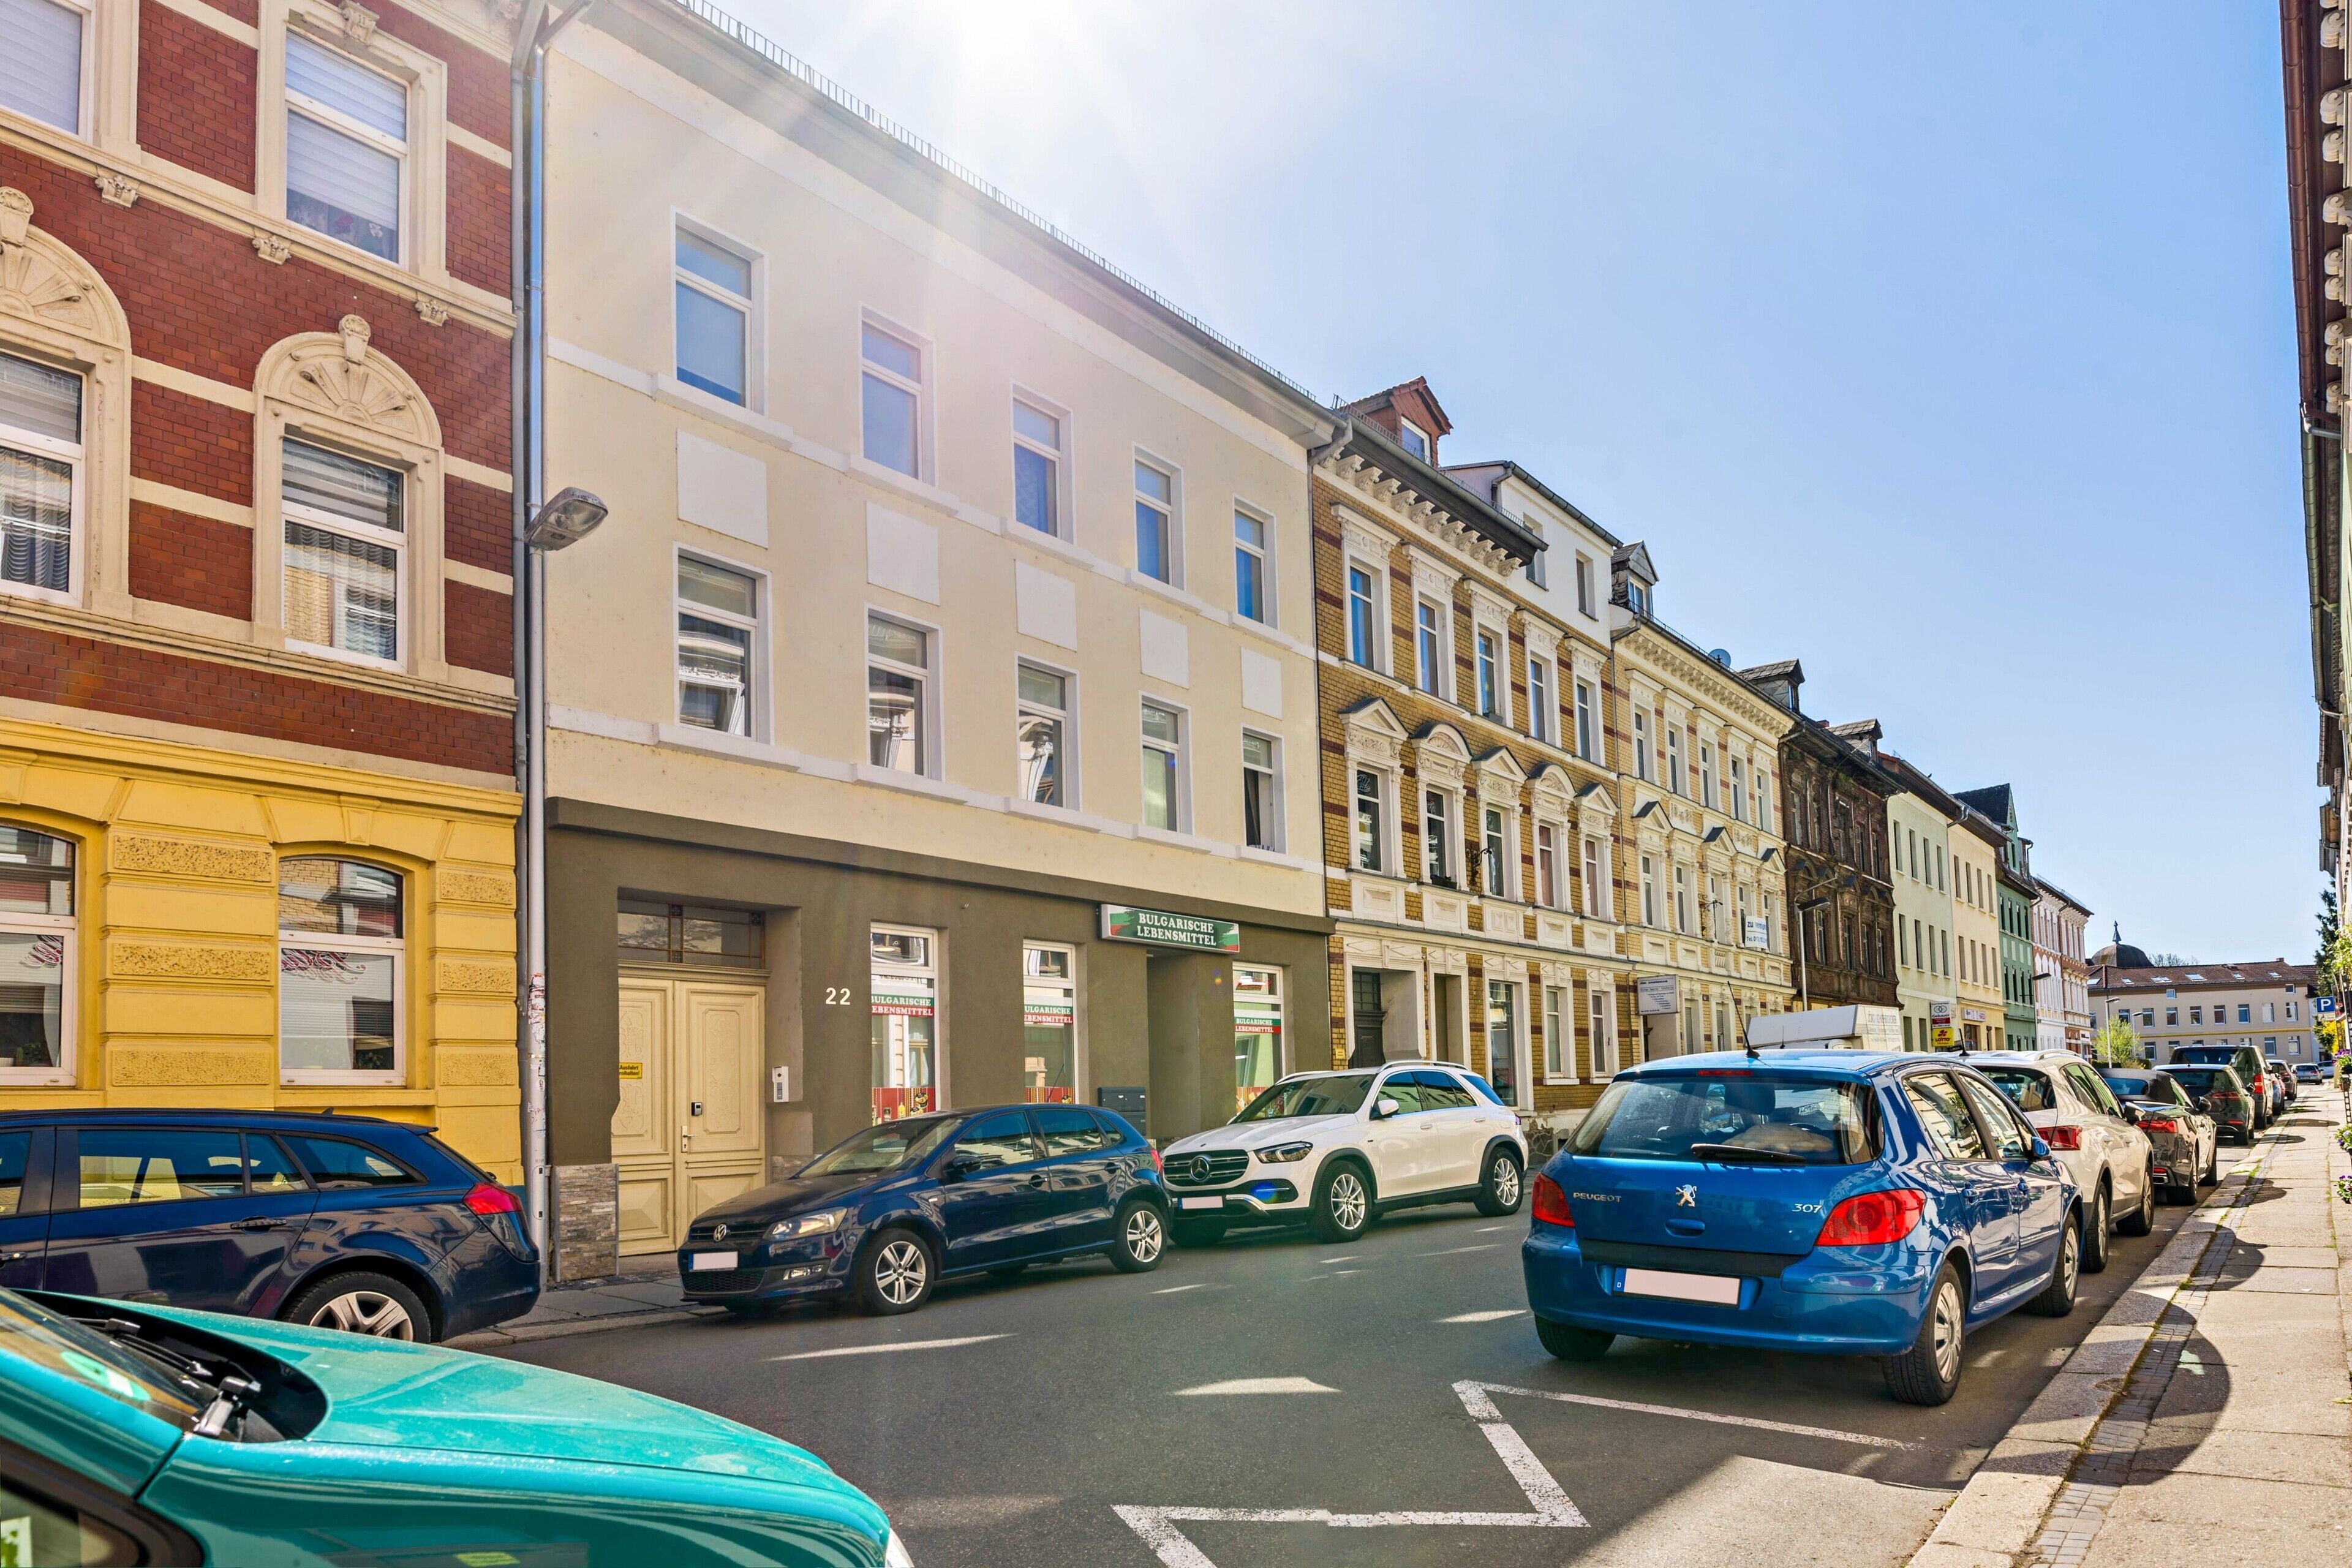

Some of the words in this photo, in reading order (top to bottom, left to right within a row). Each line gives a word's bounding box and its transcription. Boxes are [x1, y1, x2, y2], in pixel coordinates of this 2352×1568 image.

[1138, 913, 1214, 933] BULGARISCHE
[1137, 925, 1216, 946] LEBENSMITTEL
[825, 987, 851, 1005] 22
[2321, 998, 2332, 1011] P
[872, 1005, 933, 1016] EBENSMITTEL
[1024, 1006, 1071, 1015] ULGARISCHE
[1024, 1014, 1072, 1023] EBENSMITTEL
[1236, 1017, 1273, 1026] BULGARISCHE
[1573, 1192, 1622, 1202] PEUGEOT
[1792, 1204, 1822, 1213] 307
